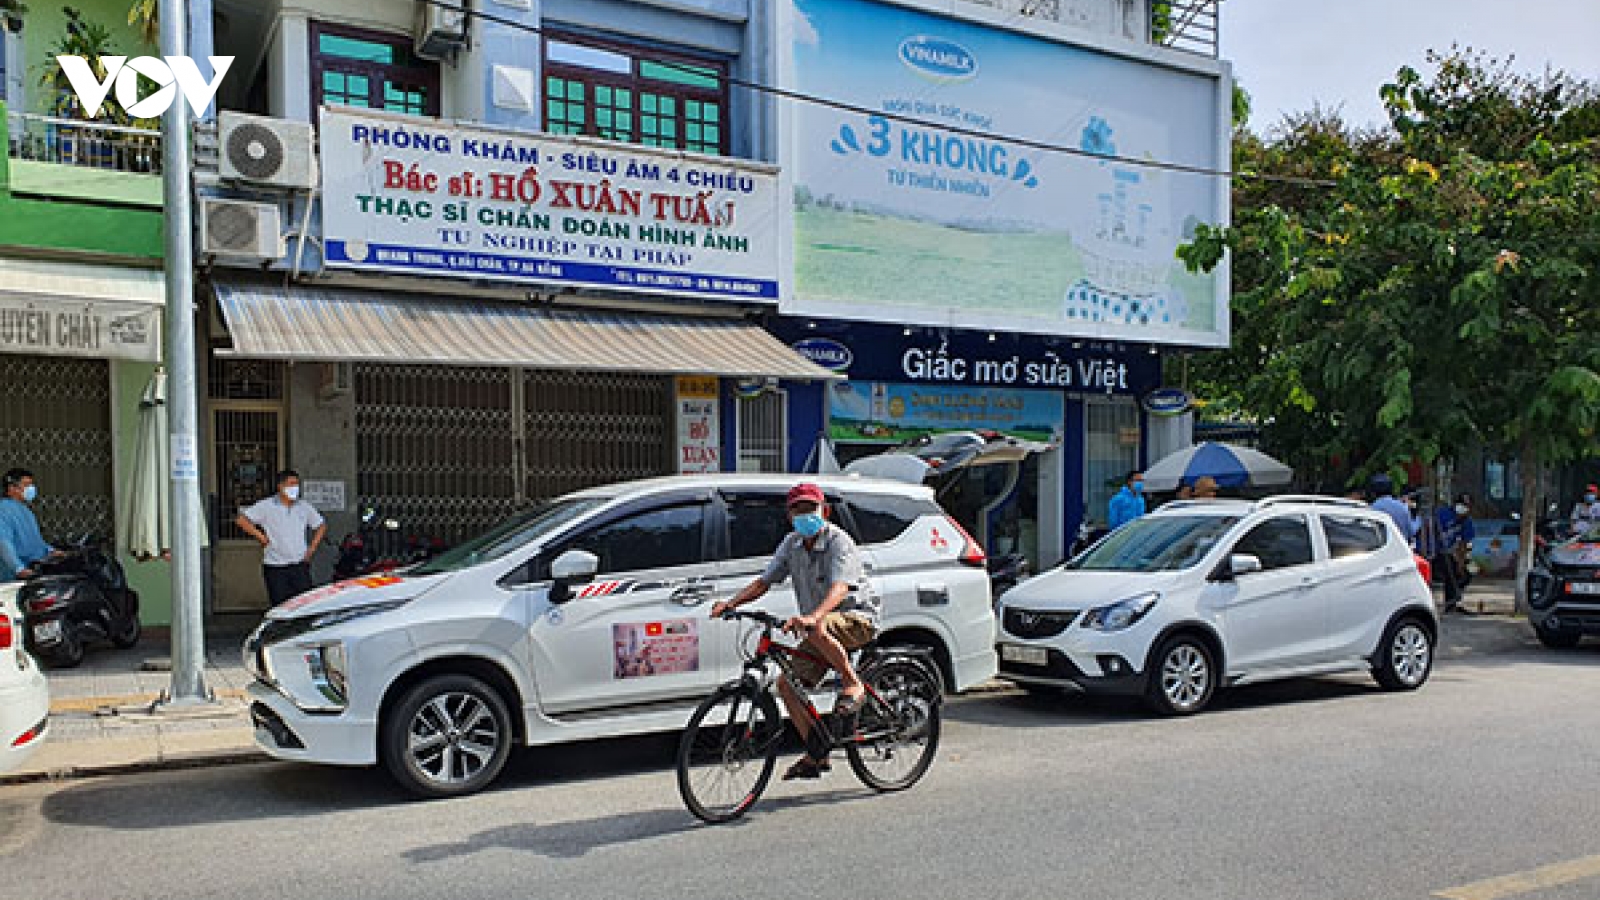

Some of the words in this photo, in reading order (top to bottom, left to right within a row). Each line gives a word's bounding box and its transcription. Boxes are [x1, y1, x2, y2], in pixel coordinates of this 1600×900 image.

[866, 115, 891, 156] 3
[383, 159, 438, 194] Bác
[448, 171, 484, 197] sĩ:
[488, 166, 542, 205] HỒ
[550, 178, 643, 217] XUÂN
[562, 150, 617, 175] SIÊU
[626, 159, 659, 181] ÂM
[667, 168, 680, 183] 4
[355, 194, 433, 223] THẠC
[562, 215, 630, 240] ĐOÁN
[639, 222, 696, 247] HÌNH
[704, 227, 748, 253] ẢNH
[482, 232, 577, 258] NGHIỆP
[56, 303, 101, 349] CHẤT
[902, 334, 967, 381] Giấc
[975, 355, 1020, 383] mơ
[1025, 350, 1073, 385] sữa
[1077, 358, 1129, 394] Việt
